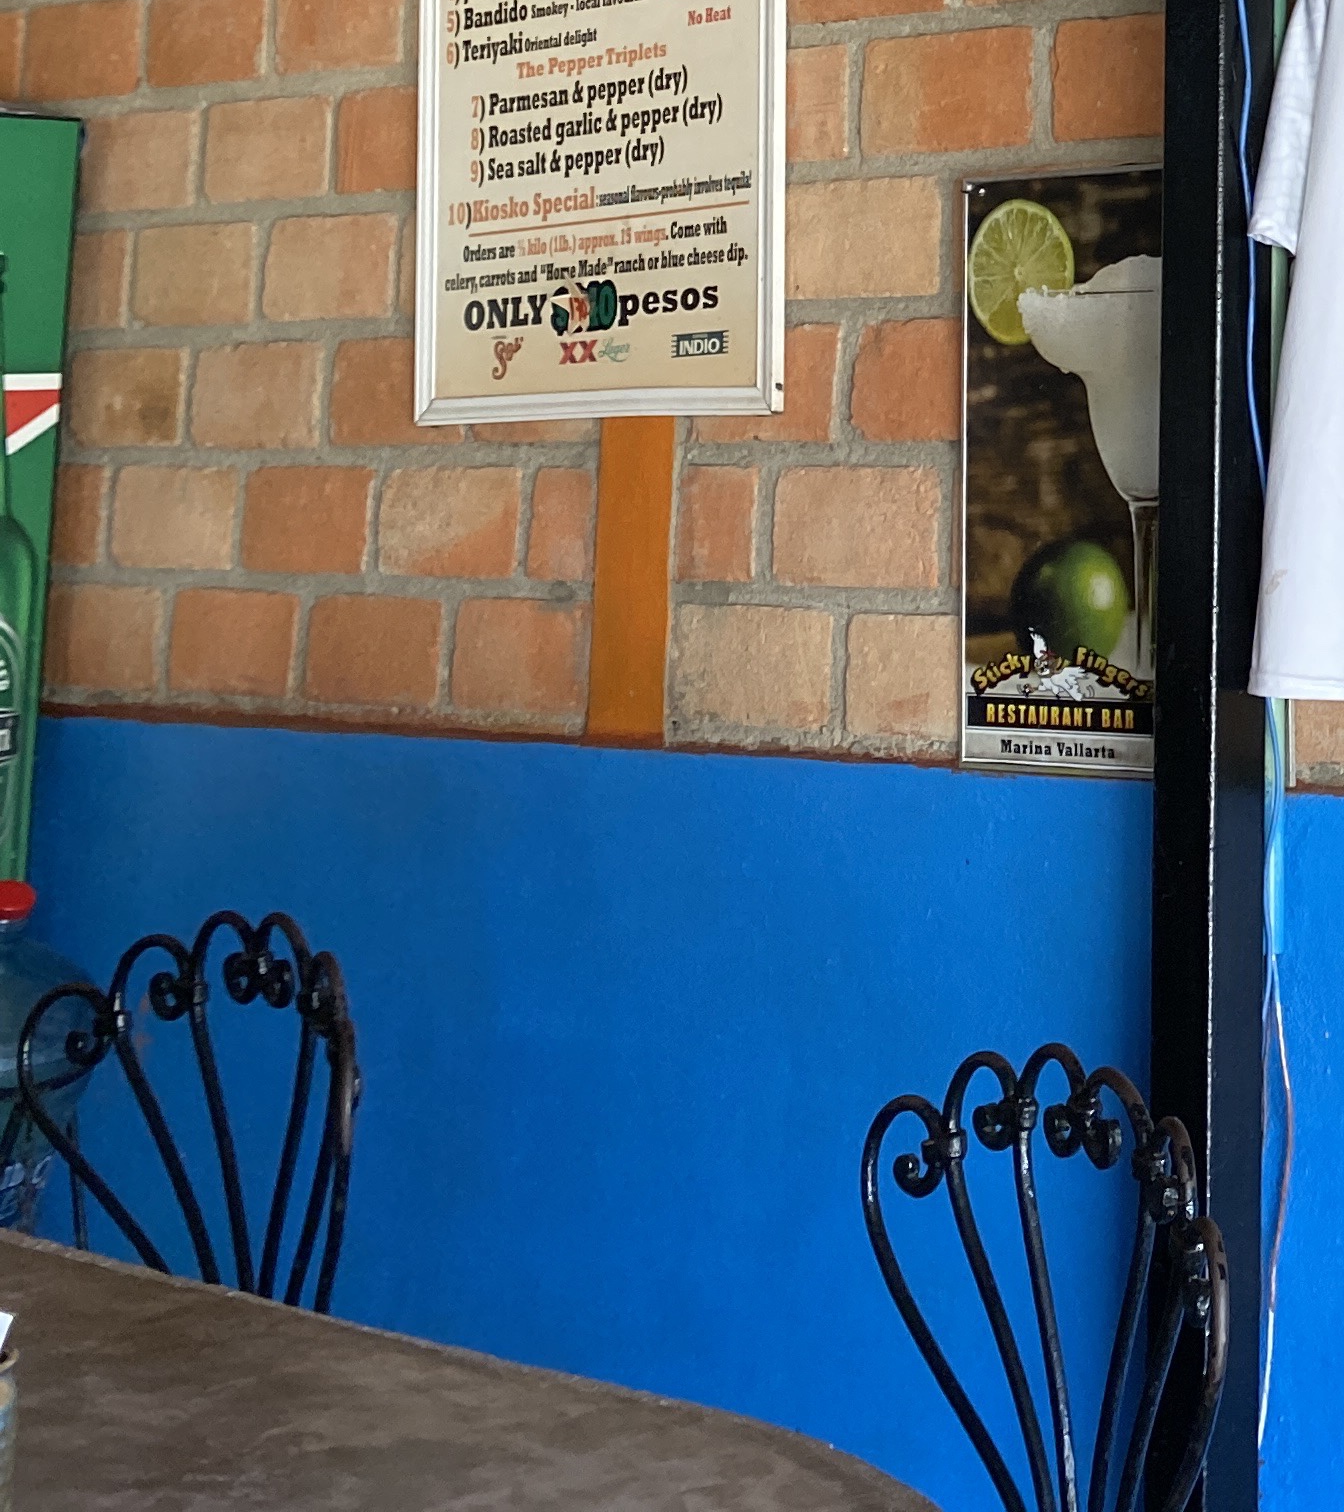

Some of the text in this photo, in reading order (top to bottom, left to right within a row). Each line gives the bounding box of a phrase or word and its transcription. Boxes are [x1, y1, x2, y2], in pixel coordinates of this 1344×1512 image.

[462, 5, 731, 64] Teriyaki Oriental delight No Heat
[464, 0, 527, 30] Bandido
[531, 1, 568, 19] Smokey
[517, 42, 667, 79] The Pepper Triplets
[489, 64, 688, 115] Parmesan pepper (dry)
[488, 93, 723, 148] Roasted garlic pepper (dry)
[488, 136, 665, 181] Sea salt pepper (dry)
[472, 196, 529, 222] Kiosko
[463, 244, 496, 262] Orders
[499, 245, 515, 259] are
[528, 237, 546, 255] kilo
[671, 221, 700, 239] Come
[703, 216, 727, 235] with
[480, 269, 515, 288] carrots
[518, 265, 537, 283] and
[614, 254, 645, 274] ranch
[661, 250, 685, 269] blue
[687, 248, 724, 266] cheese
[727, 243, 748, 266] dip.
[464, 293, 547, 330] ONLY
[619, 286, 718, 326] pesos
[559, 339, 598, 365] XX
[679, 338, 720, 355] INDIO
[972, 646, 1149, 697] Sticky Fingers
[986, 703, 1134, 729] RESTAURANT BAR
[1000, 739, 1115, 759] Marina Vallarta
